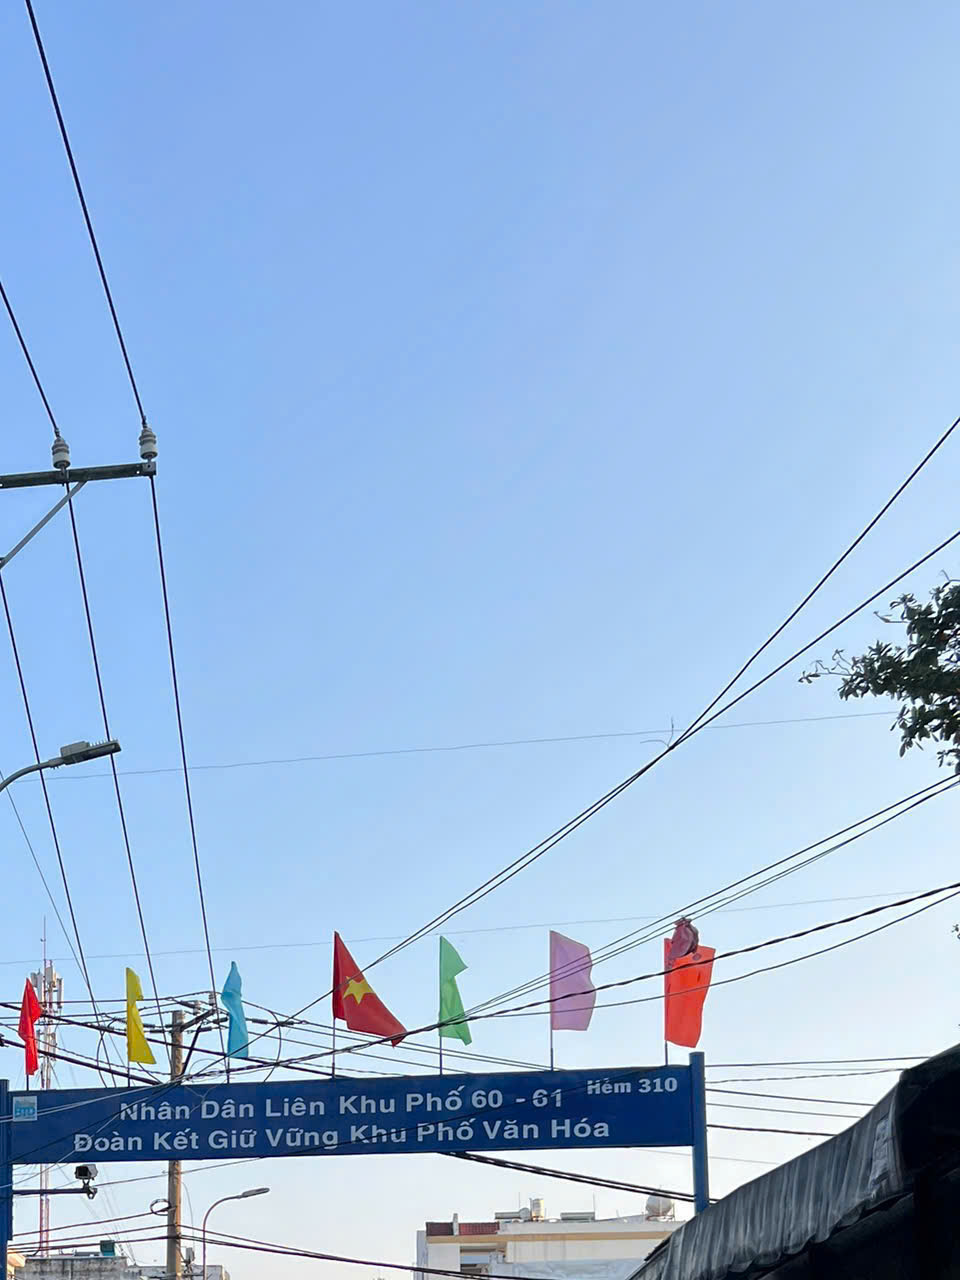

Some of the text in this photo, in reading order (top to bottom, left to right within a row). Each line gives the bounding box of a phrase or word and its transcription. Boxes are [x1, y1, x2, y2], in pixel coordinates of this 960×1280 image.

[119, 1100, 190, 1121] Nhân
[201, 1099, 254, 1119] Dân
[265, 1097, 325, 1117] Liên
[339, 1095, 395, 1114] Khu
[406, 1085, 465, 1112] Phố
[471, 1089, 503, 1108] 60
[532, 1088, 562, 1107] 61
[638, 1077, 678, 1093] 310
[72, 1117, 609, 1153] Đoàn Kết Giữ Vững Khu Phố Văn Hóa
